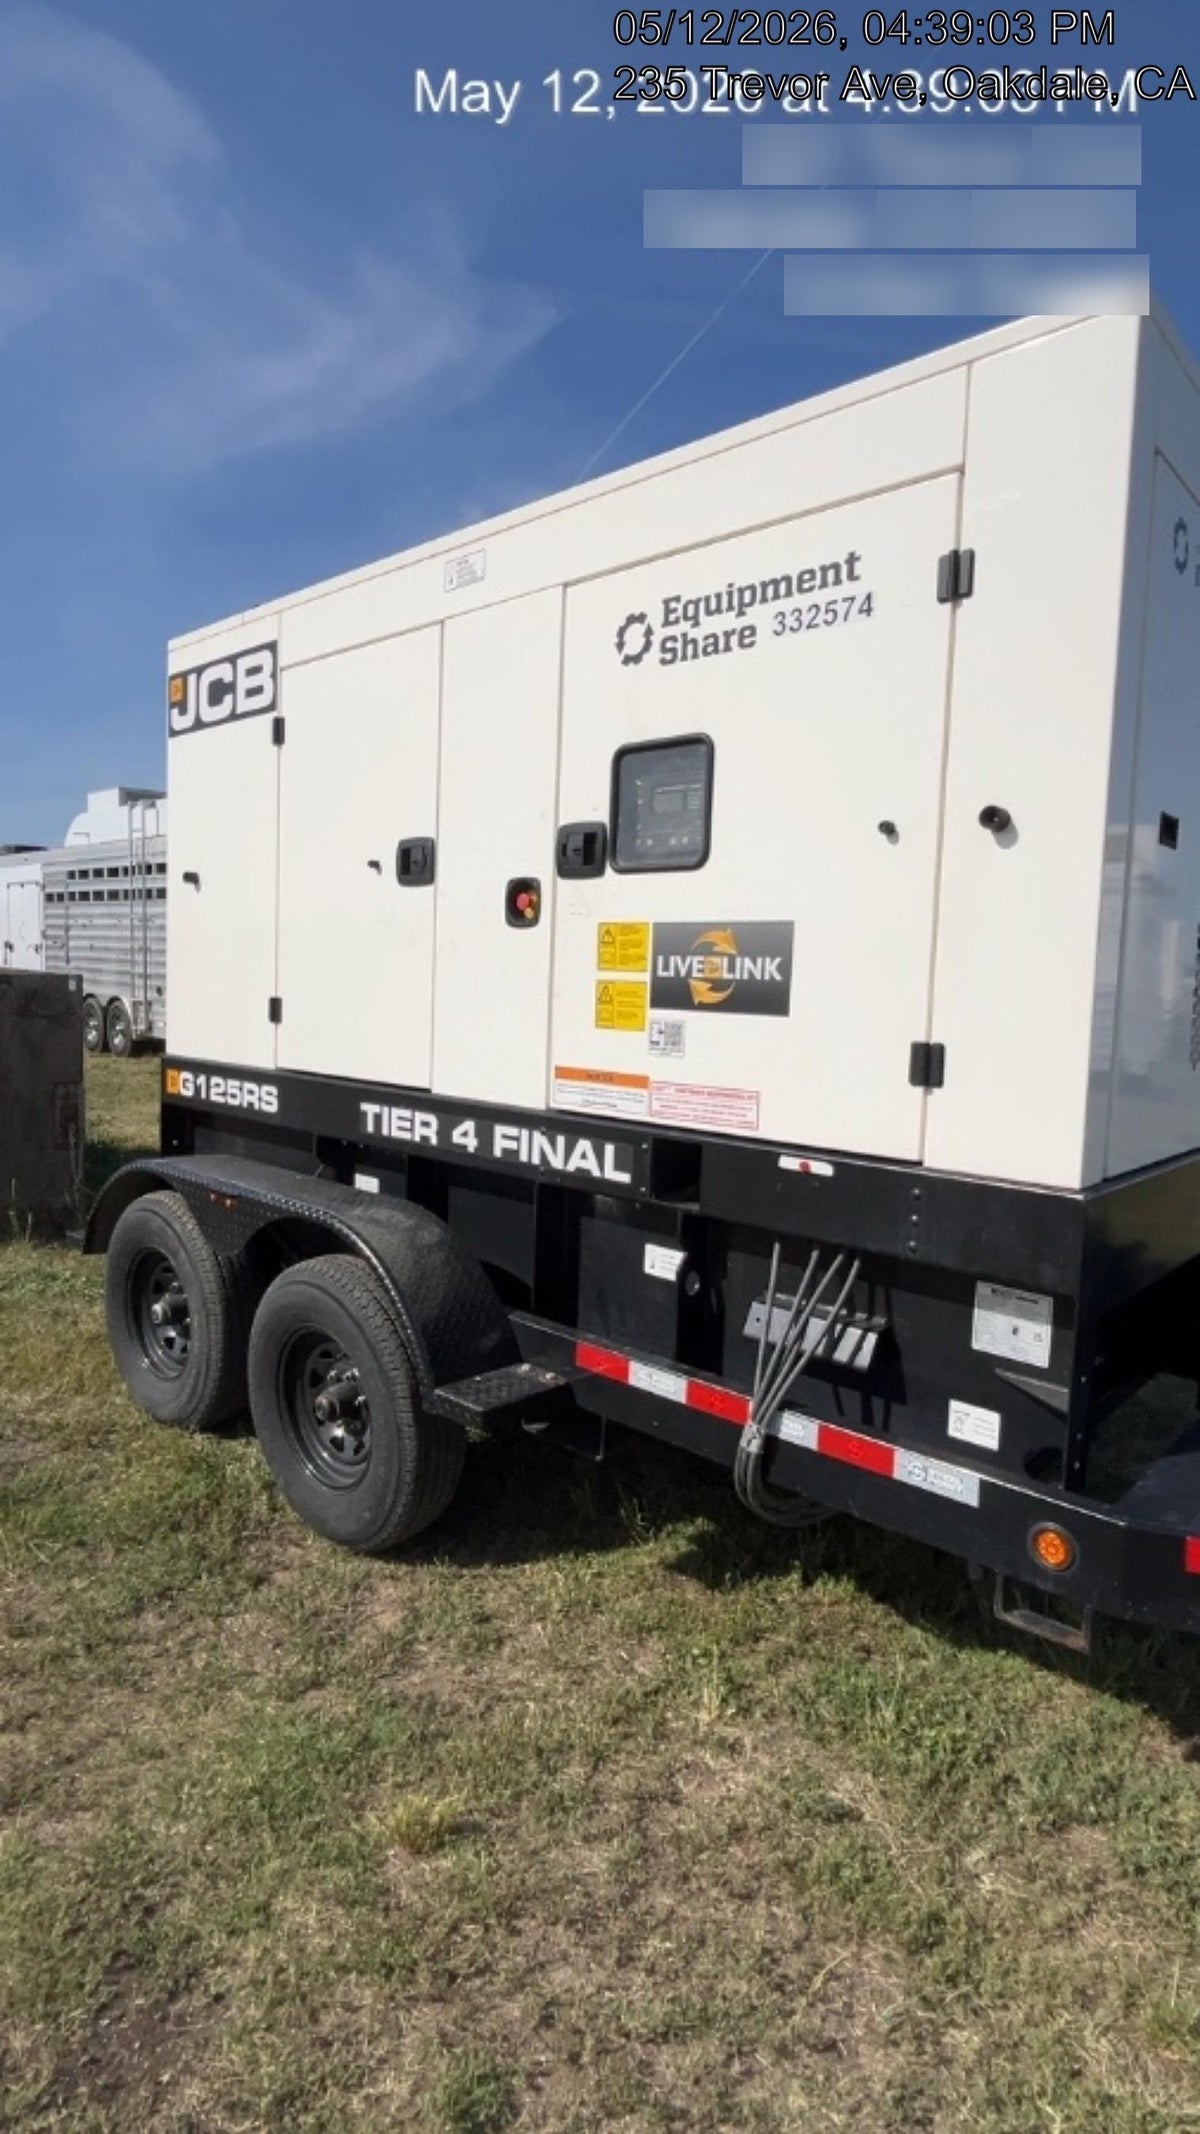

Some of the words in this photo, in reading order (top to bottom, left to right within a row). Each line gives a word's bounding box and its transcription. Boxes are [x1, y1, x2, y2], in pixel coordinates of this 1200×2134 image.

[658, 622, 757, 666] Share
[772, 591, 874, 638] 332574
[660, 550, 862, 629] Equipment
[170, 649, 274, 732] JCB
[179, 1071, 279, 1113] G125RS
[360, 1102, 438, 1147] TIER
[451, 1120, 478, 1154] 4
[493, 1125, 632, 1185] FINAL
